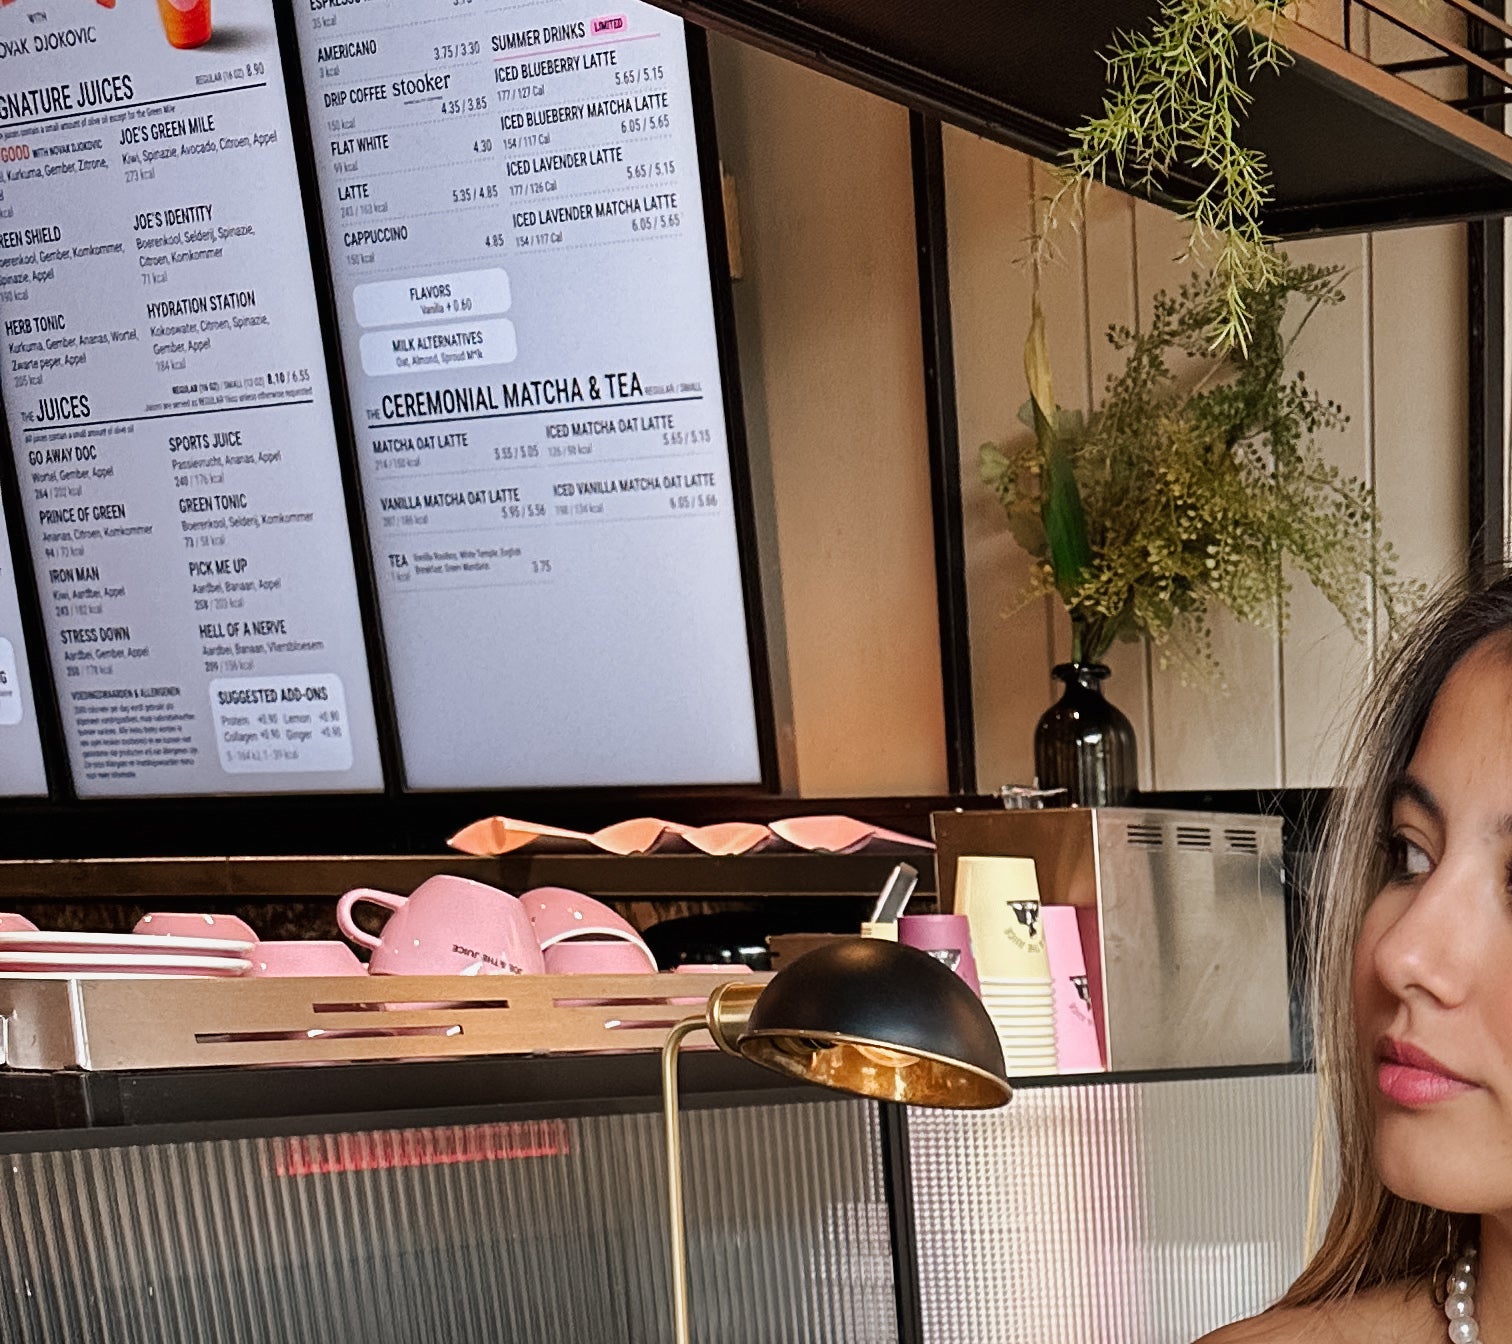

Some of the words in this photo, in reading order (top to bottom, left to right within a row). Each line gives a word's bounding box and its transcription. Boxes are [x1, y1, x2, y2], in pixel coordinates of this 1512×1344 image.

[33, 26, 97, 53] DJOKOVIC
[491, 28, 541, 52] SUMMER
[542, 21, 586, 44] DRINKS
[593, 17, 623, 33] LIMITED
[317, 39, 377, 63] AMERICANO
[433, 44, 453, 61] 3.75
[460, 40, 480, 57] 3.30
[245, 61, 265, 77] 8.90
[494, 65, 519, 83] ICED
[520, 55, 580, 79] BLUEBERRY
[582, 49, 617, 70] LATTE
[614, 69, 635, 86] 5.65
[642, 65, 664, 82] 5.15
[76, 74, 134, 108] JUICES
[323, 90, 347, 108] DRIP
[349, 84, 387, 104] COFFEE
[391, 72, 451, 97] stooker
[441, 99, 461, 114] 4.35
[467, 95, 487, 112] 3.85
[500, 113, 524, 131] ICED
[525, 104, 584, 127] BLUEBERRY
[586, 97, 633, 118] MATCHA
[634, 91, 668, 112] LATTE
[119, 125, 149, 146] JOE'S
[150, 119, 187, 141] GREEN
[187, 114, 216, 135] MILE
[620, 117, 641, 134] 6.05
[648, 113, 670, 130] 5.65
[252, 129, 278, 147] Appel
[330, 138, 355, 157] FLAT
[355, 133, 389, 153] WHITE
[472, 138, 493, 153] 4.30
[0, 143, 30, 164] GOOD
[506, 159, 531, 177] ICED
[532, 151, 588, 173] LAVENDER
[588, 146, 623, 166] LATTE
[626, 163, 647, 180] 5.65
[654, 160, 675, 176] 5.15
[337, 182, 370, 201] LATTE
[451, 187, 472, 203] 5.35
[478, 184, 498, 199] 4.85
[132, 211, 163, 231] JOE'S
[163, 203, 212, 227] IDENTITY
[512, 211, 537, 228] ICED
[538, 203, 594, 225] LAVENDER
[594, 198, 642, 218] MATCHA
[642, 192, 678, 212] LATTE
[631, 216, 652, 232] 6.05
[659, 212, 680, 228] 5.65
[24, 225, 61, 246] SHIELD
[343, 224, 408, 248] CAPPUCCINO
[484, 233, 505, 248] 4.85
[408, 283, 452, 301] FLAVORS
[146, 296, 208, 319] HYDRATION
[208, 289, 256, 312] STATION
[3, 318, 33, 337] HERB
[32, 313, 66, 333] TONIC
[391, 337, 415, 352] MILK
[417, 330, 484, 350] ALTERNATIVES
[266, 371, 285, 385] 8.10
[291, 368, 310, 383] 6.55
[381, 385, 499, 420] CEREMONIAL
[501, 376, 584, 409] MATCHA
[588, 375, 602, 401] &
[603, 371, 643, 399] TEA
[35, 394, 91, 422] JUICES
[545, 423, 570, 439] ICED
[570, 419, 616, 436] MATCHA
[617, 417, 638, 433] OAT
[640, 414, 674, 431] LATTE
[168, 433, 210, 453] SPORTS
[211, 430, 243, 449] JUICE
[371, 438, 415, 454] MATCHA
[415, 435, 435, 450] OAT
[436, 432, 469, 449] LATTE
[27, 449, 44, 466] GO
[45, 447, 73, 465] AWAY
[74, 444, 97, 462] DOC
[552, 482, 575, 497] ICED
[575, 480, 618, 495] VANILLA
[618, 477, 662, 492] MATCHA
[662, 474, 682, 489] OAT
[683, 472, 715, 488] LATTE
[178, 496, 213, 514] GREEN
[213, 493, 247, 510] TONIC
[379, 495, 422, 511] VANILLA
[423, 492, 466, 508] MATCHA
[467, 489, 486, 505] OAT
[487, 487, 521, 504] LATTE
[38, 507, 76, 526] PRINCE
[76, 506, 90, 522] OF
[92, 503, 126, 521] GREEN
[188, 560, 214, 577] PICK
[214, 558, 232, 574] ME
[232, 557, 248, 574] UP
[387, 553, 409, 568] TEA
[48, 568, 75, 584] IRON
[74, 566, 100, 582] MAN
[59, 627, 98, 645] STRESS
[98, 626, 131, 642] DOWN
[198, 623, 226, 639] HELL
[226, 621, 240, 638] OF
[243, 621, 251, 636] A
[251, 619, 287, 636] NERVE
[217, 688, 278, 706] SUGGESTED
[280, 685, 328, 702] ADD-ONS
[452, 944, 480, 959] JUICE
